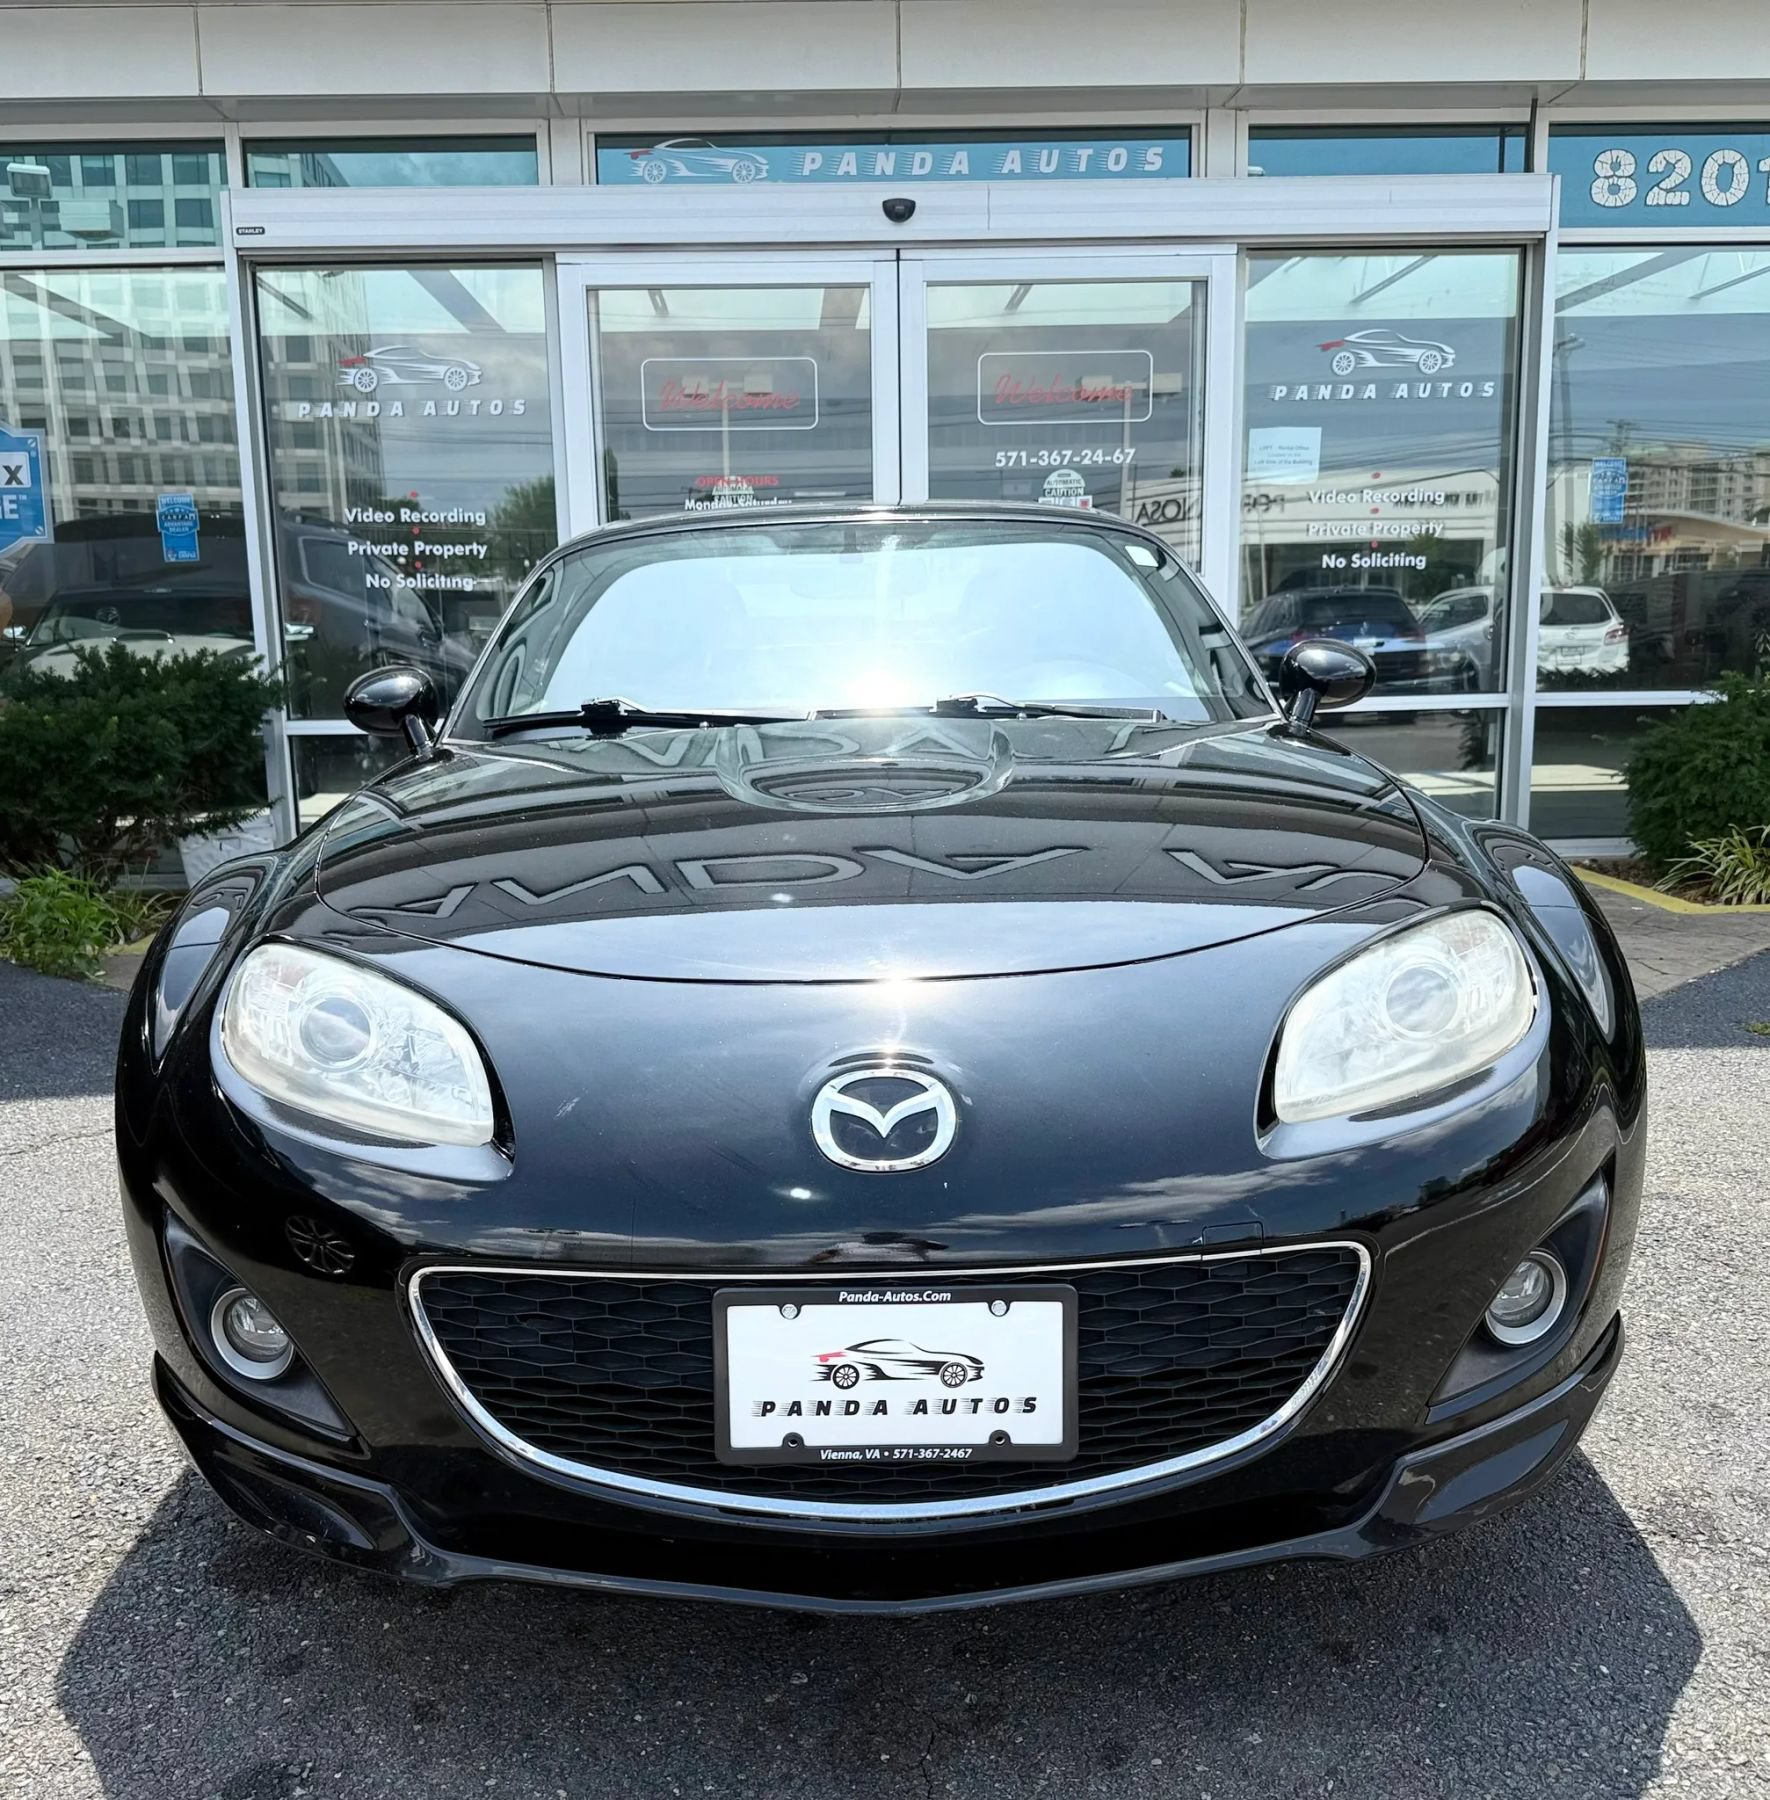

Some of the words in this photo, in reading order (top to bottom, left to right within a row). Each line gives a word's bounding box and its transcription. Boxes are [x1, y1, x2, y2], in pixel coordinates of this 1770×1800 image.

[791, 151, 970, 177] PANDA
[990, 147, 1164, 174] AUTOS
[658, 378, 800, 412] Welcome
[1271, 383, 1377, 401] PANDA
[1393, 381, 1495, 399] AUTOS
[298, 401, 404, 418] PANDA
[423, 399, 527, 417] AUTOS
[994, 447, 1136, 468] 571-367-24-67
[1044, 488, 1085, 498] CAUTION
[1308, 489, 1357, 505] Video
[1362, 487, 1446, 505] Recording
[344, 507, 395, 523] Video
[400, 507, 486, 526] Recording
[1306, 522, 1368, 537] Private
[1372, 521, 1445, 539] Property
[347, 541, 409, 556] Private
[413, 541, 488, 559] Property
[1321, 554, 1347, 569] No
[1350, 552, 1427, 570] Soliciting
[365, 573, 391, 588] No
[396, 573, 476, 591] Soliciting
[837, 1289, 952, 1303] Panda-Autos.Com
[752, 1399, 889, 1417] PANDA
[903, 1396, 1037, 1416] AUTOS
[819, 1448, 864, 1462] Vienna,
[864, 1448, 881, 1460] VA
[892, 1447, 973, 1460] 571-367-2467
